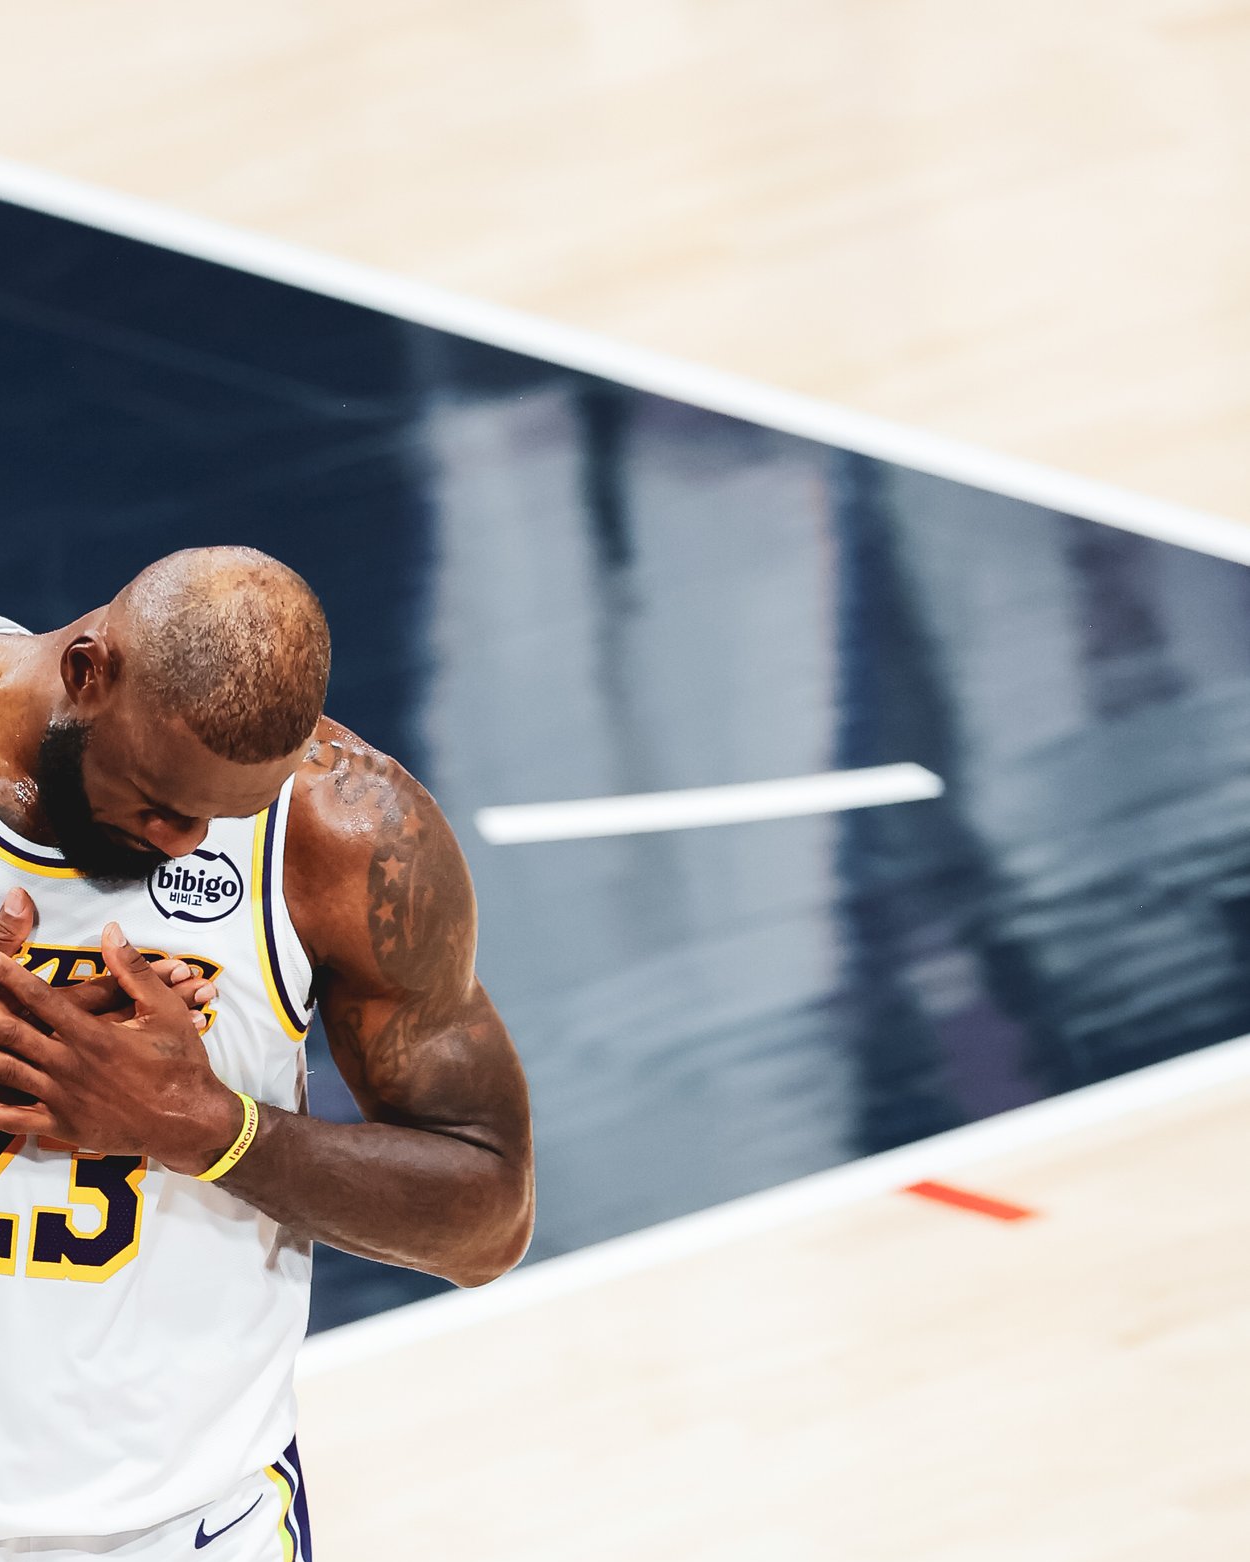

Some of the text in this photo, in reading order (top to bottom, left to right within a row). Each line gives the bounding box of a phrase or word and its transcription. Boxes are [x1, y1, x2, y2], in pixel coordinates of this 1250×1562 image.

[157, 865, 237, 903] bibigo
[169, 892, 203, 907] 비비고
[233, 1104, 257, 1156] PROMISE
